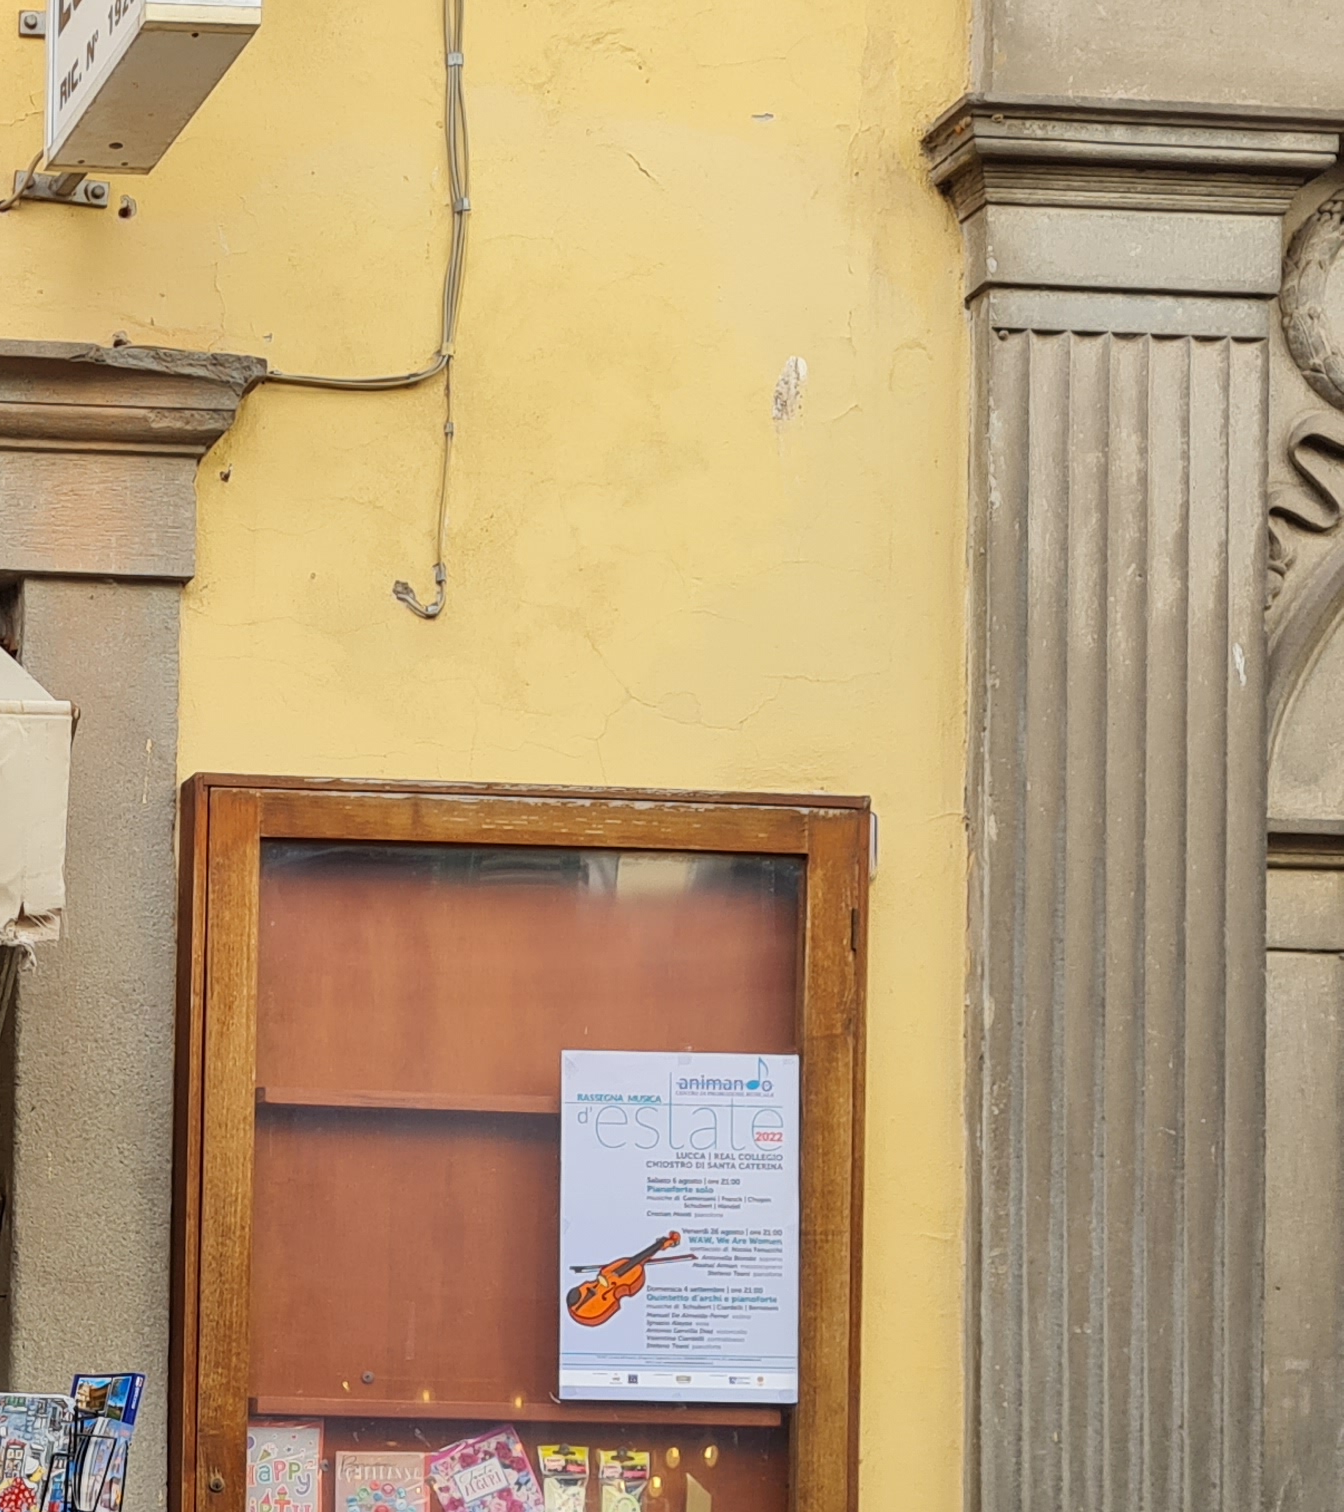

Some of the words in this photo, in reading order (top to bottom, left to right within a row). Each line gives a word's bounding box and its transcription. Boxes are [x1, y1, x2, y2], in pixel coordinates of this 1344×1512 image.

[754, 1131, 784, 1142] 2022
[675, 1152, 706, 1160] LUCCA
[713, 1153, 736, 1161] REAL
[738, 1153, 784, 1161] COLLEGIO
[645, 1160, 693, 1169] CHIOSTRO
[695, 1161, 705, 1169] DI
[707, 1161, 737, 1170] SANTA
[738, 1162, 784, 1171] CATERINA
